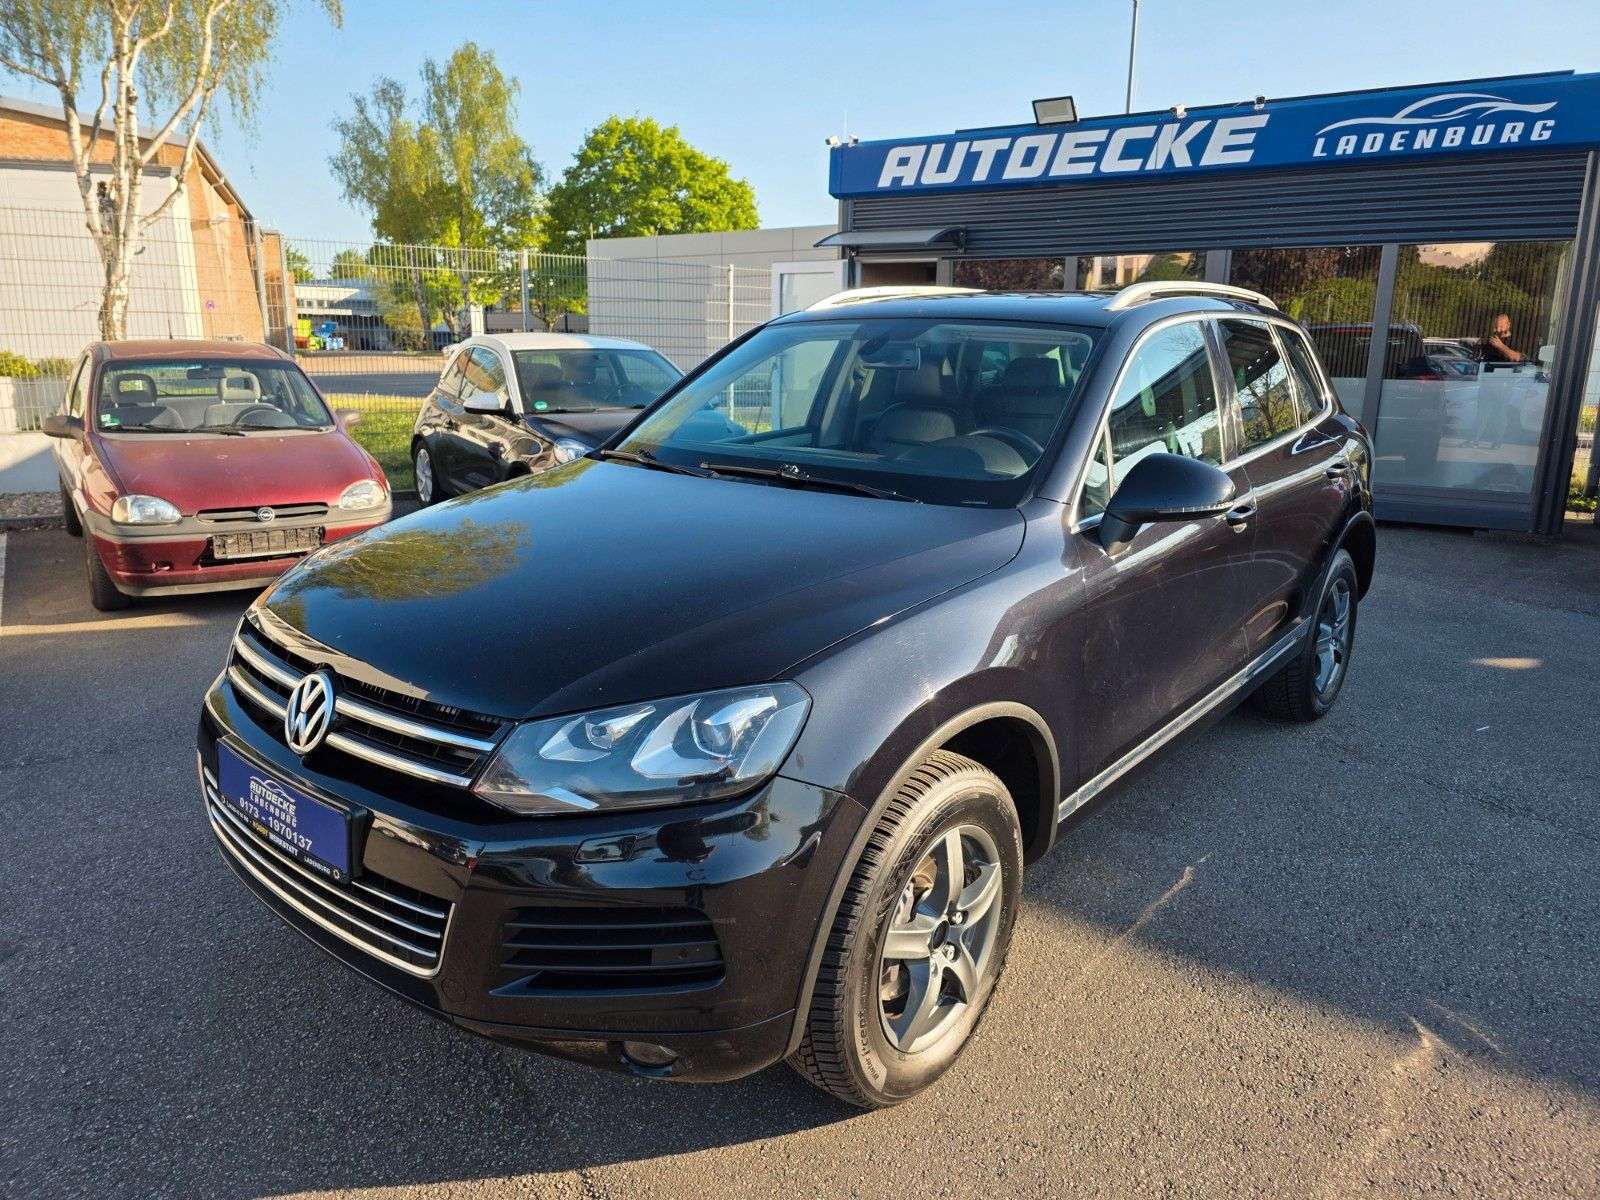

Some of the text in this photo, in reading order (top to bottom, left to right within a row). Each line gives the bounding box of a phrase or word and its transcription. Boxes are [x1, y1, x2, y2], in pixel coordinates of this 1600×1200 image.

[876, 114, 1270, 188] AUTOECKE
[1312, 119, 1556, 157] LADENBURG
[250, 780, 296, 817] AUTOECKE
[250, 791, 297, 828] LADENBURG
[240, 797, 259, 818] 0173
[269, 816, 313, 851] 1970137
